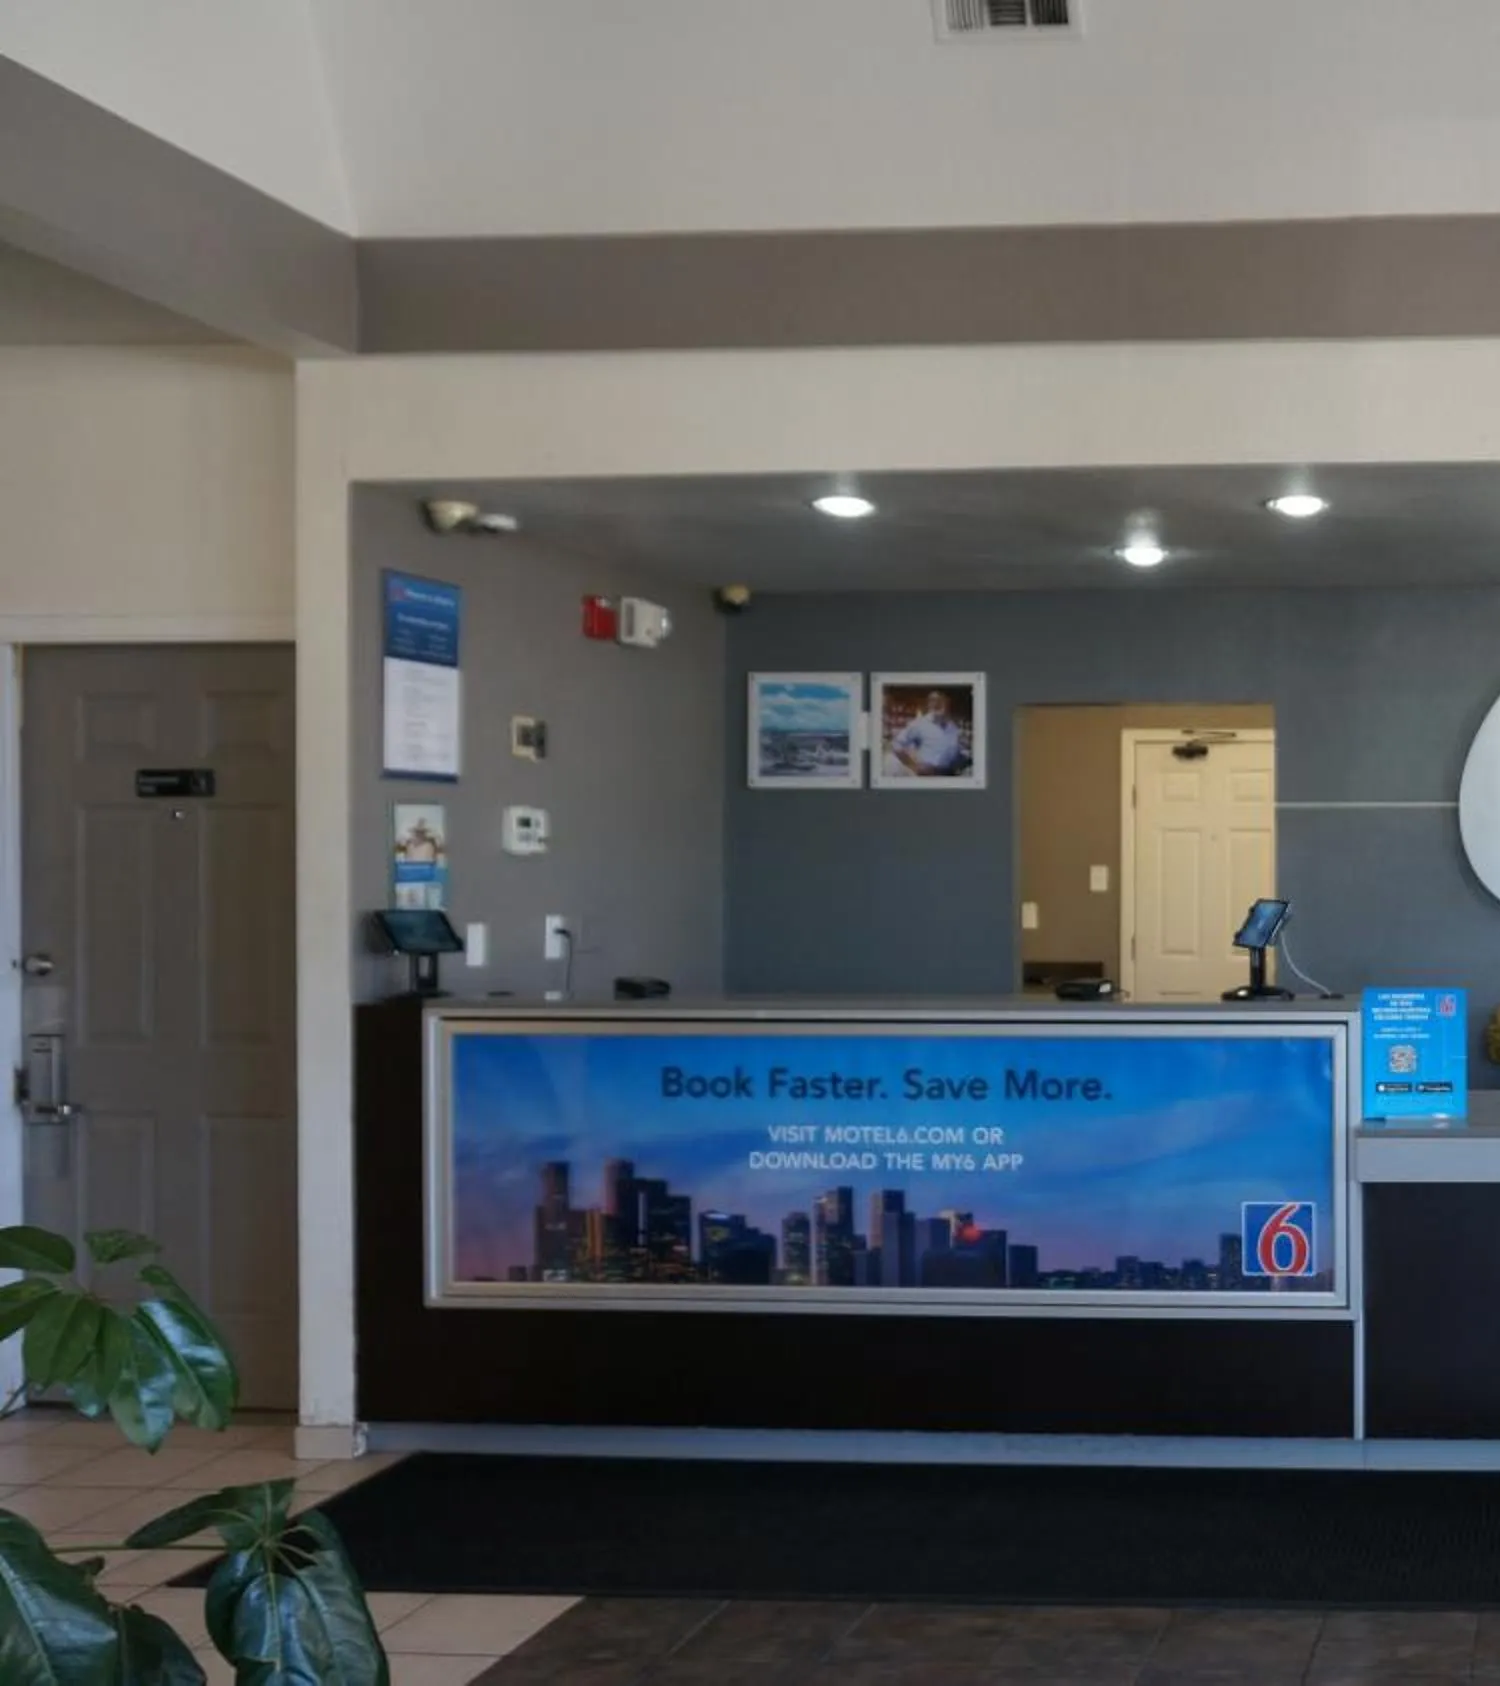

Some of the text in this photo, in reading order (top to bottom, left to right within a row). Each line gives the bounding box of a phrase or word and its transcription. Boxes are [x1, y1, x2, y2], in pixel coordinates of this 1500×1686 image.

[661, 1066, 1113, 1100] Book Faster. Save More.
[767, 1125, 1004, 1145] VISIT MOTEL6.COM OR
[749, 1152, 1024, 1171] DOWNLOAD THE MY6 APP
[1257, 1202, 1309, 1275] 6
